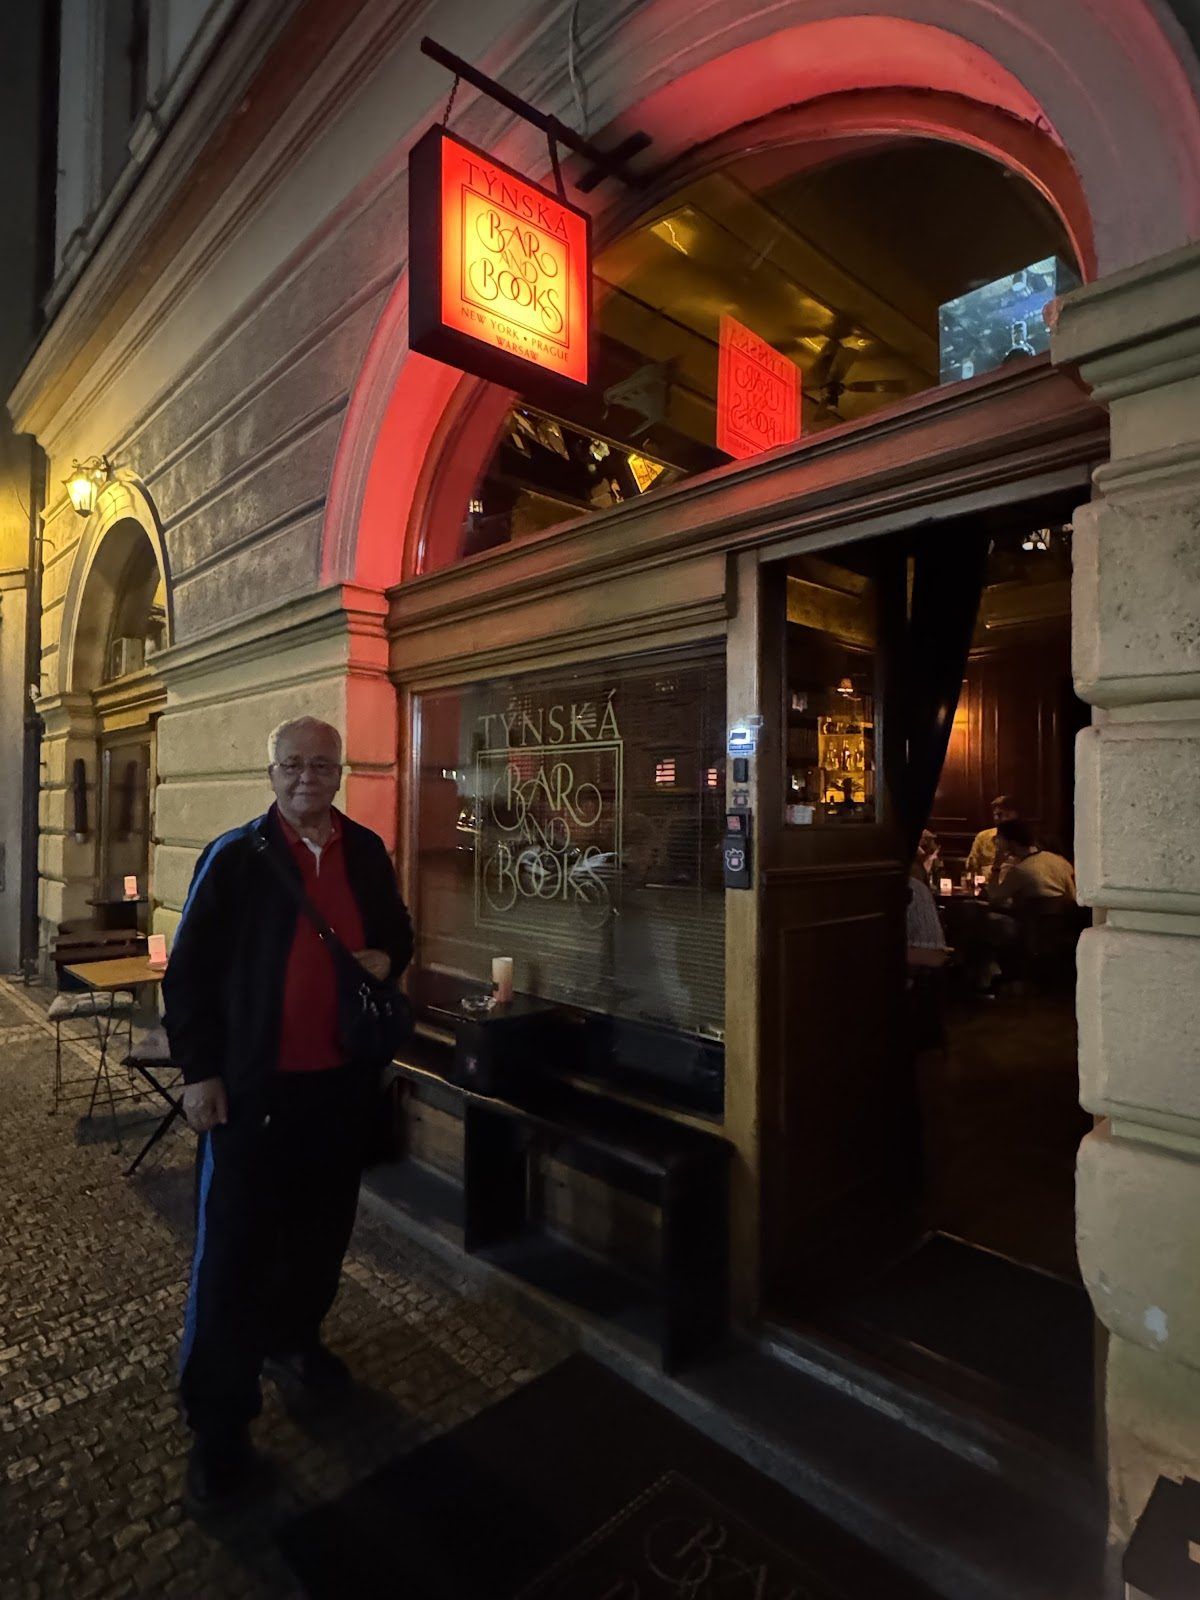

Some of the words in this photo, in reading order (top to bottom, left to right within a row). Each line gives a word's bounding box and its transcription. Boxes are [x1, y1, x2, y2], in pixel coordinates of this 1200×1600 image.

[462, 159, 569, 239] TÝNSKÁ
[475, 209, 558, 278] BAR
[499, 249, 538, 284] AND
[469, 258, 563, 334] BOOKS
[461, 307, 487, 326] NEW
[491, 319, 520, 340] YORK
[531, 338, 569, 362] PRAGUE
[495, 335, 539, 361] WARSAW
[491, 762, 602, 832] BAR
[519, 813, 570, 854] AND
[484, 842, 612, 930] BOOKS
